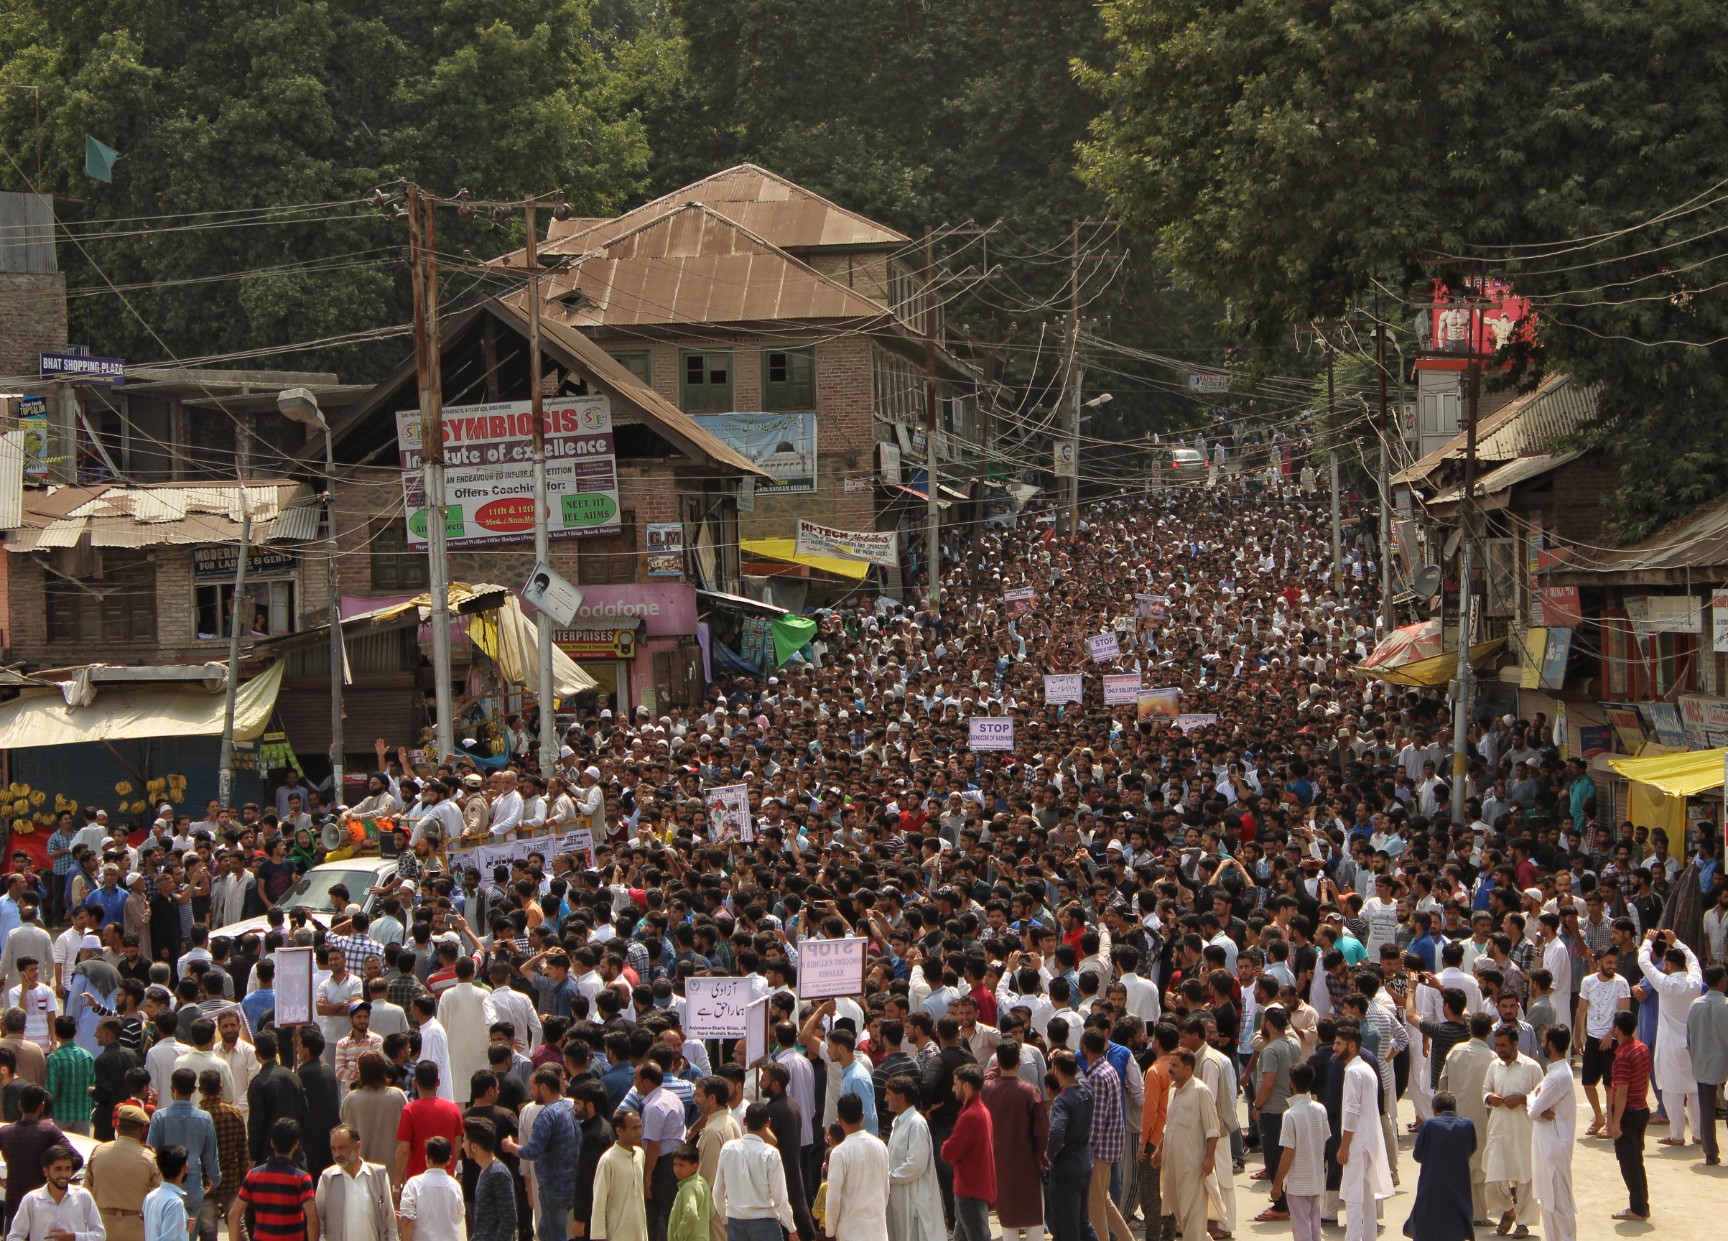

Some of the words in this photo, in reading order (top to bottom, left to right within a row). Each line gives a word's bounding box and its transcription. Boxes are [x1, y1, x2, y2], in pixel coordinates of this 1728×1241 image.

[43, 357, 62, 370] BHAT
[64, 358, 99, 373] SHOPPING
[101, 362, 124, 375] PLAZA
[405, 448, 481, 468] Intute
[487, 444, 506, 462] of
[512, 438, 607, 460] exellence
[446, 476, 455, 484] AN
[456, 473, 494, 483] ENDEAVOUR
[455, 488, 489, 498] Offers
[492, 483, 535, 495] Coachin
[547, 481, 566, 490] for:
[489, 506, 506, 515] 11th
[509, 505, 515, 513] &
[592, 498, 605, 507] IIT
[508, 515, 535, 524] Non-Me
[583, 510, 610, 520] AIIMS
[416, 525, 427, 533] All
[801, 522, 848, 539] HI-TECH
[194, 546, 239, 562] MODERN
[200, 562, 215, 570] FOR
[218, 557, 252, 568] LADS
[264, 555, 292, 564] GENTS
[579, 599, 660, 618] odafone
[1095, 637, 1114, 647] STOP
[980, 723, 1010, 733] STOP
[711, 981, 738, 998] آزادی
[697, 1007, 712, 1022] ہے
[714, 1002, 728, 1018] حق
